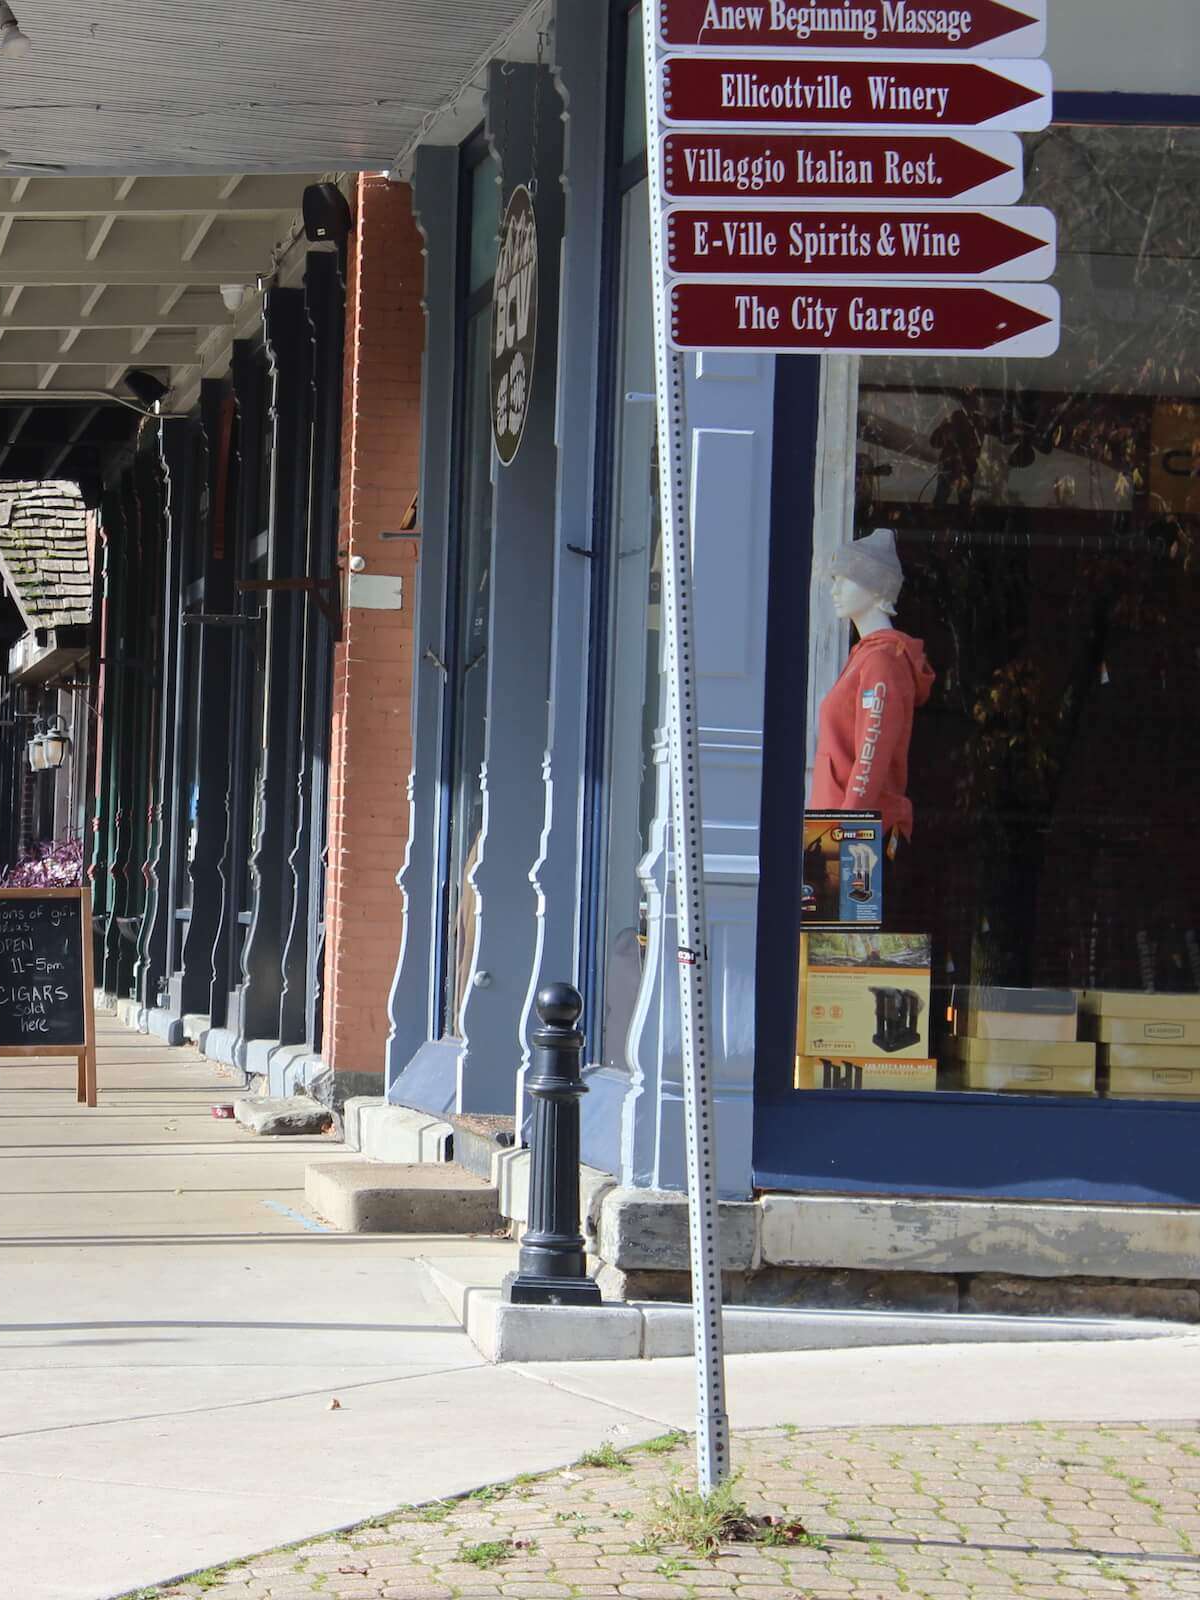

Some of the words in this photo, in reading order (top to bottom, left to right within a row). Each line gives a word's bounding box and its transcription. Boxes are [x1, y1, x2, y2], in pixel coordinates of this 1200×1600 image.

[703, 0, 763, 30] Anew
[769, 0, 877, 39] Beginning
[881, 0, 972, 41] Massage
[721, 73, 852, 109] Ellicottville
[868, 76, 950, 117] Winery
[684, 148, 786, 190] Villaggio
[797, 150, 873, 184] Italian
[884, 151, 943, 185] Rest.
[694, 221, 777, 257] E-Ville
[789, 223, 871, 263] Spirits
[876, 223, 896, 257] &
[900, 222, 961, 257] Wine
[735, 296, 780, 330] The
[791, 297, 838, 337] City
[849, 297, 935, 338] Garage
[853, 682, 887, 797] carhartt
[29, 905, 43, 919] of
[20, 1017, 49, 1033] here
